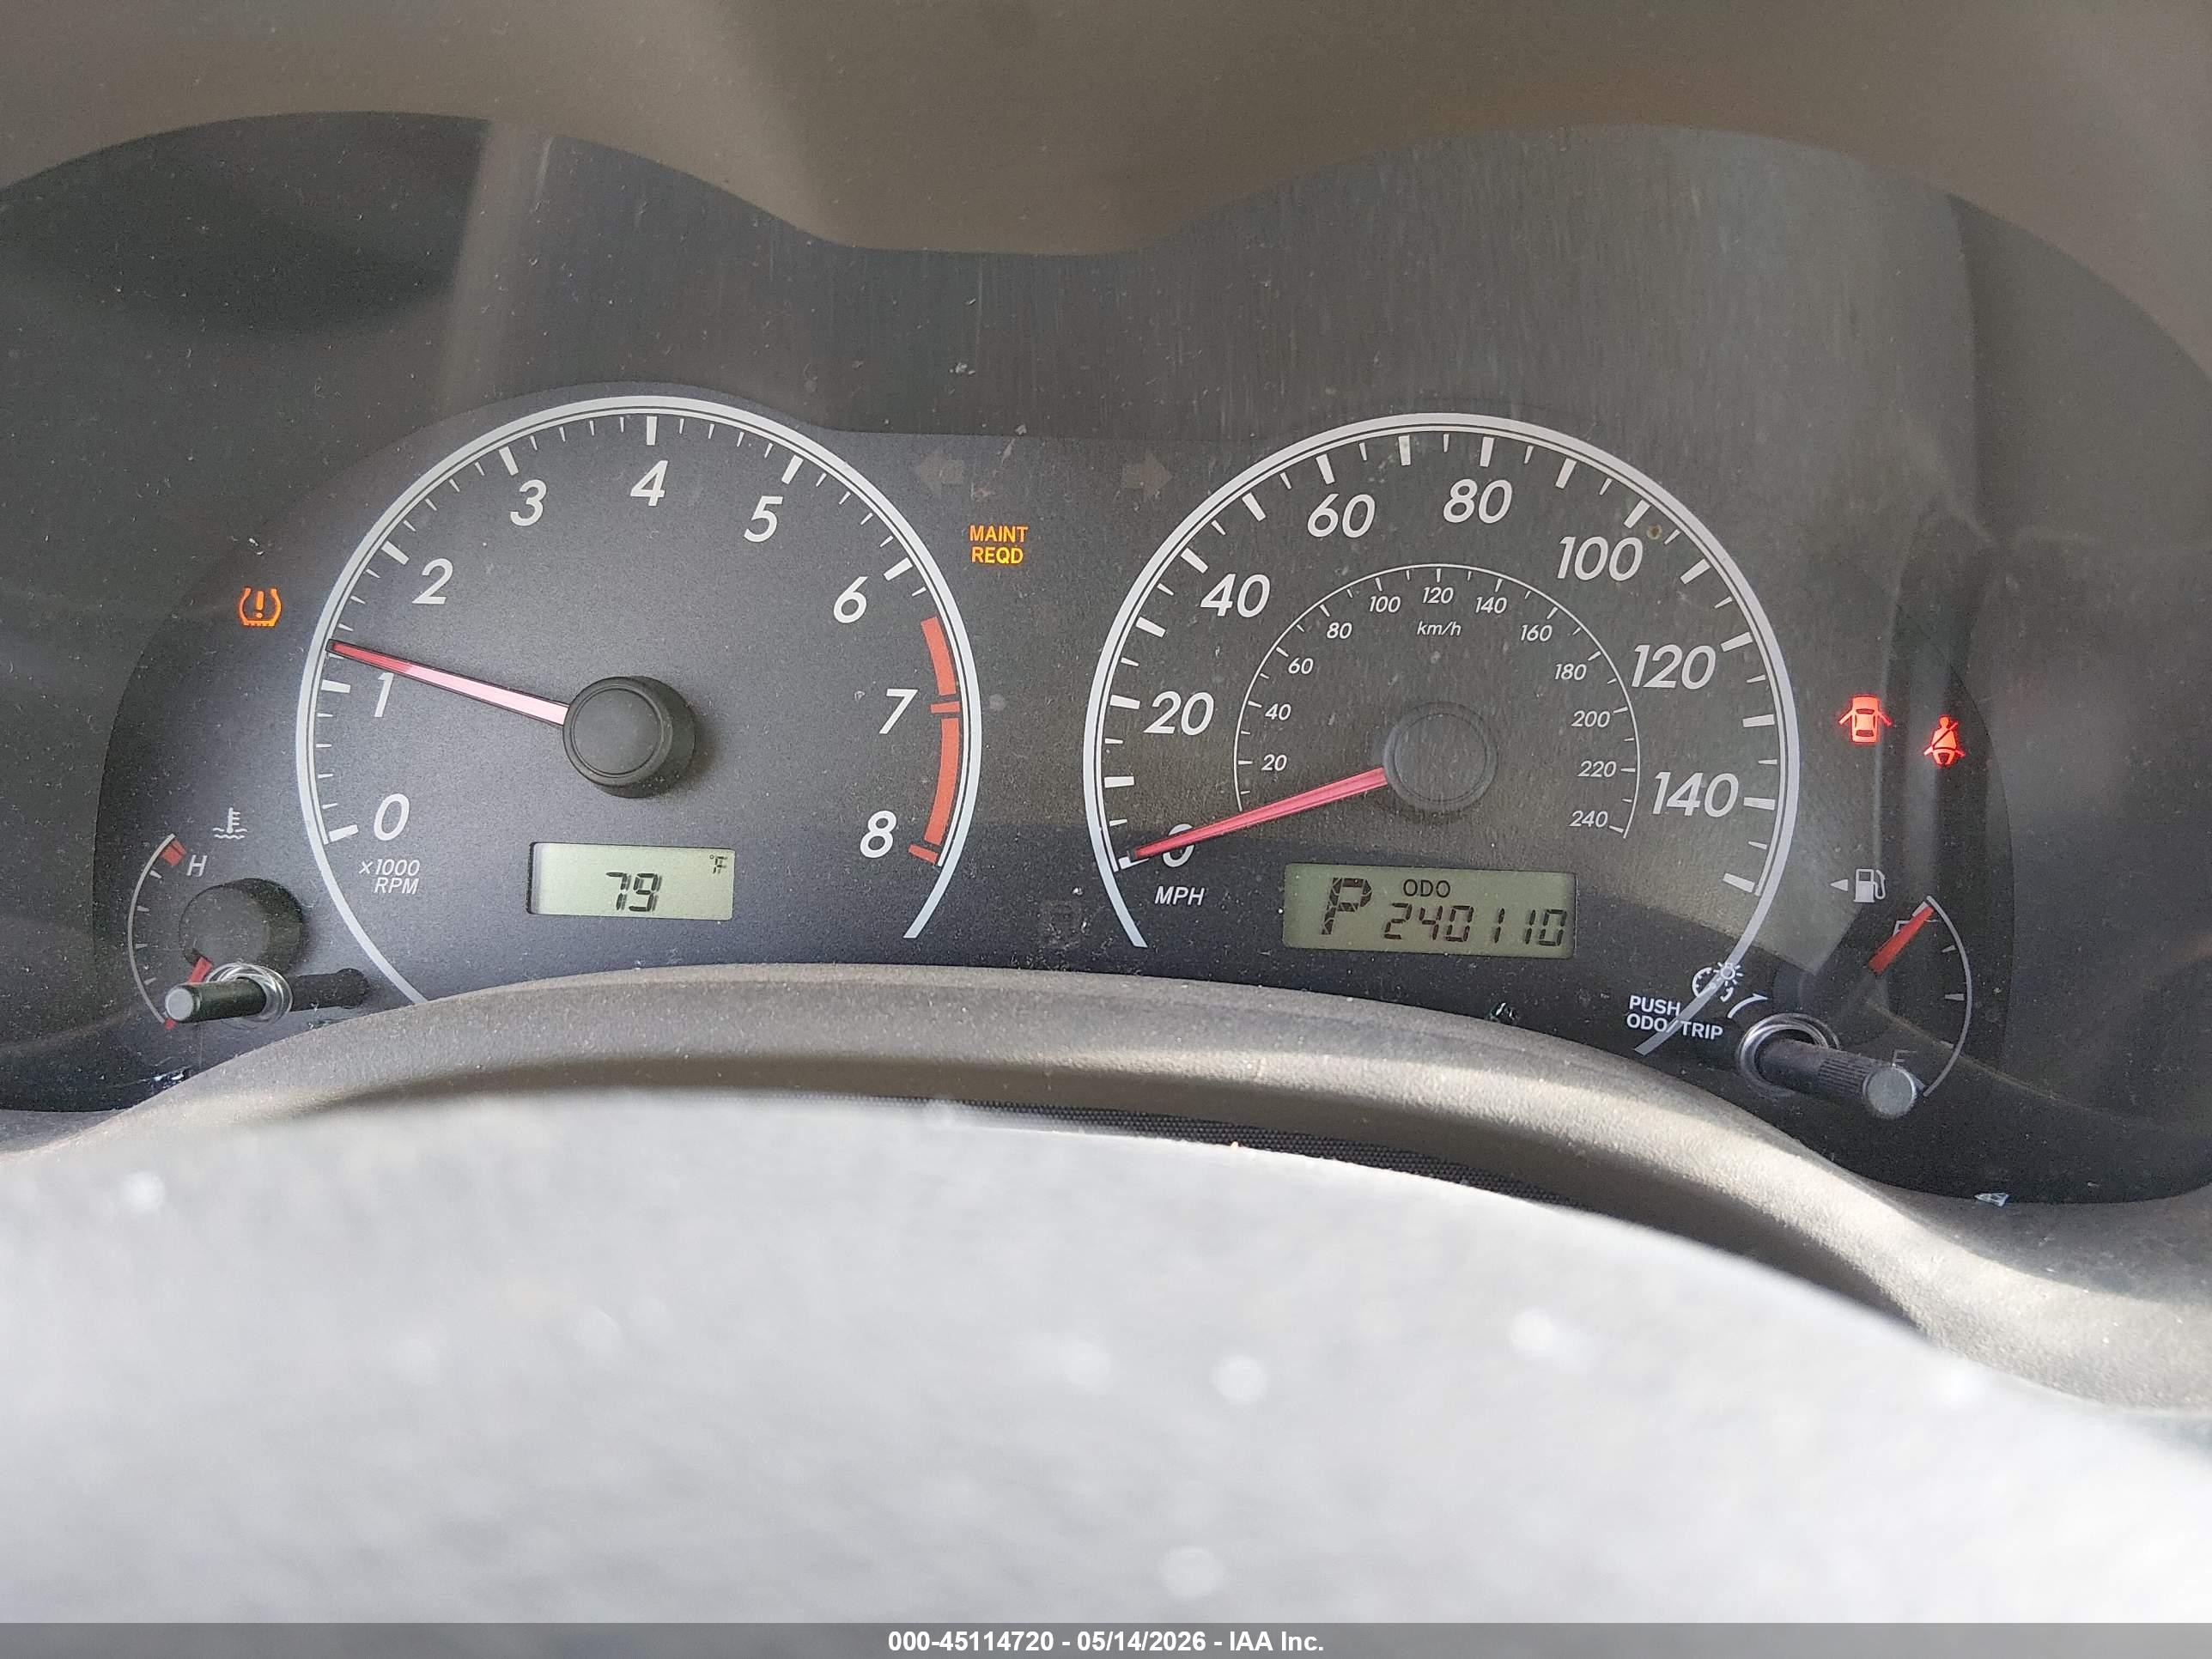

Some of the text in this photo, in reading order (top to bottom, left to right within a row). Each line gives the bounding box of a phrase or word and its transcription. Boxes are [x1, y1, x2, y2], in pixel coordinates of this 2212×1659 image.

[630, 460, 667, 506] 4
[510, 480, 546, 526] 3
[1308, 494, 1375, 538] 60
[1443, 478, 1512, 523] 80
[744, 496, 783, 542] 5
[970, 526, 1028, 543] MAINT
[972, 547, 1023, 563] REQD
[1558, 537, 1643, 581] 100
[412, 558, 453, 604] 2
[1200, 574, 1269, 617] 40
[1423, 587, 1453, 604] 120
[834, 577, 867, 623] 6
[1370, 596, 1401, 612] 100
[1476, 597, 1507, 613] 140
[1327, 623, 1352, 639] 80
[1417, 621, 1461, 635] km/h
[1522, 625, 1553, 641] 160
[1289, 658, 1314, 674] 60
[1555, 664, 1586, 680] 180
[1632, 645, 1716, 689] 120
[374, 673, 393, 717] 1
[879, 689, 917, 733] 7
[1144, 691, 1214, 735] 20
[1265, 704, 1291, 720] 40
[1571, 711, 1610, 727] 200
[1261, 754, 1287, 771] 20
[1578, 760, 1617, 777] 220
[1653, 772, 1739, 817] 140
[374, 793, 409, 841] 0
[1571, 810, 1607, 827] 240
[860, 811, 896, 858] 8
[1163, 823, 1195, 867] 0
[186, 854, 208, 877] H
[374, 878, 419, 894] RPM
[606, 872, 662, 912] 79
[1155, 886, 1204, 905] MPH
[1403, 878, 1451, 898] ODO
[1321, 878, 1372, 935] P
[1384, 902, 1567, 946] 240110
[1629, 994, 1680, 1016] PUSH
